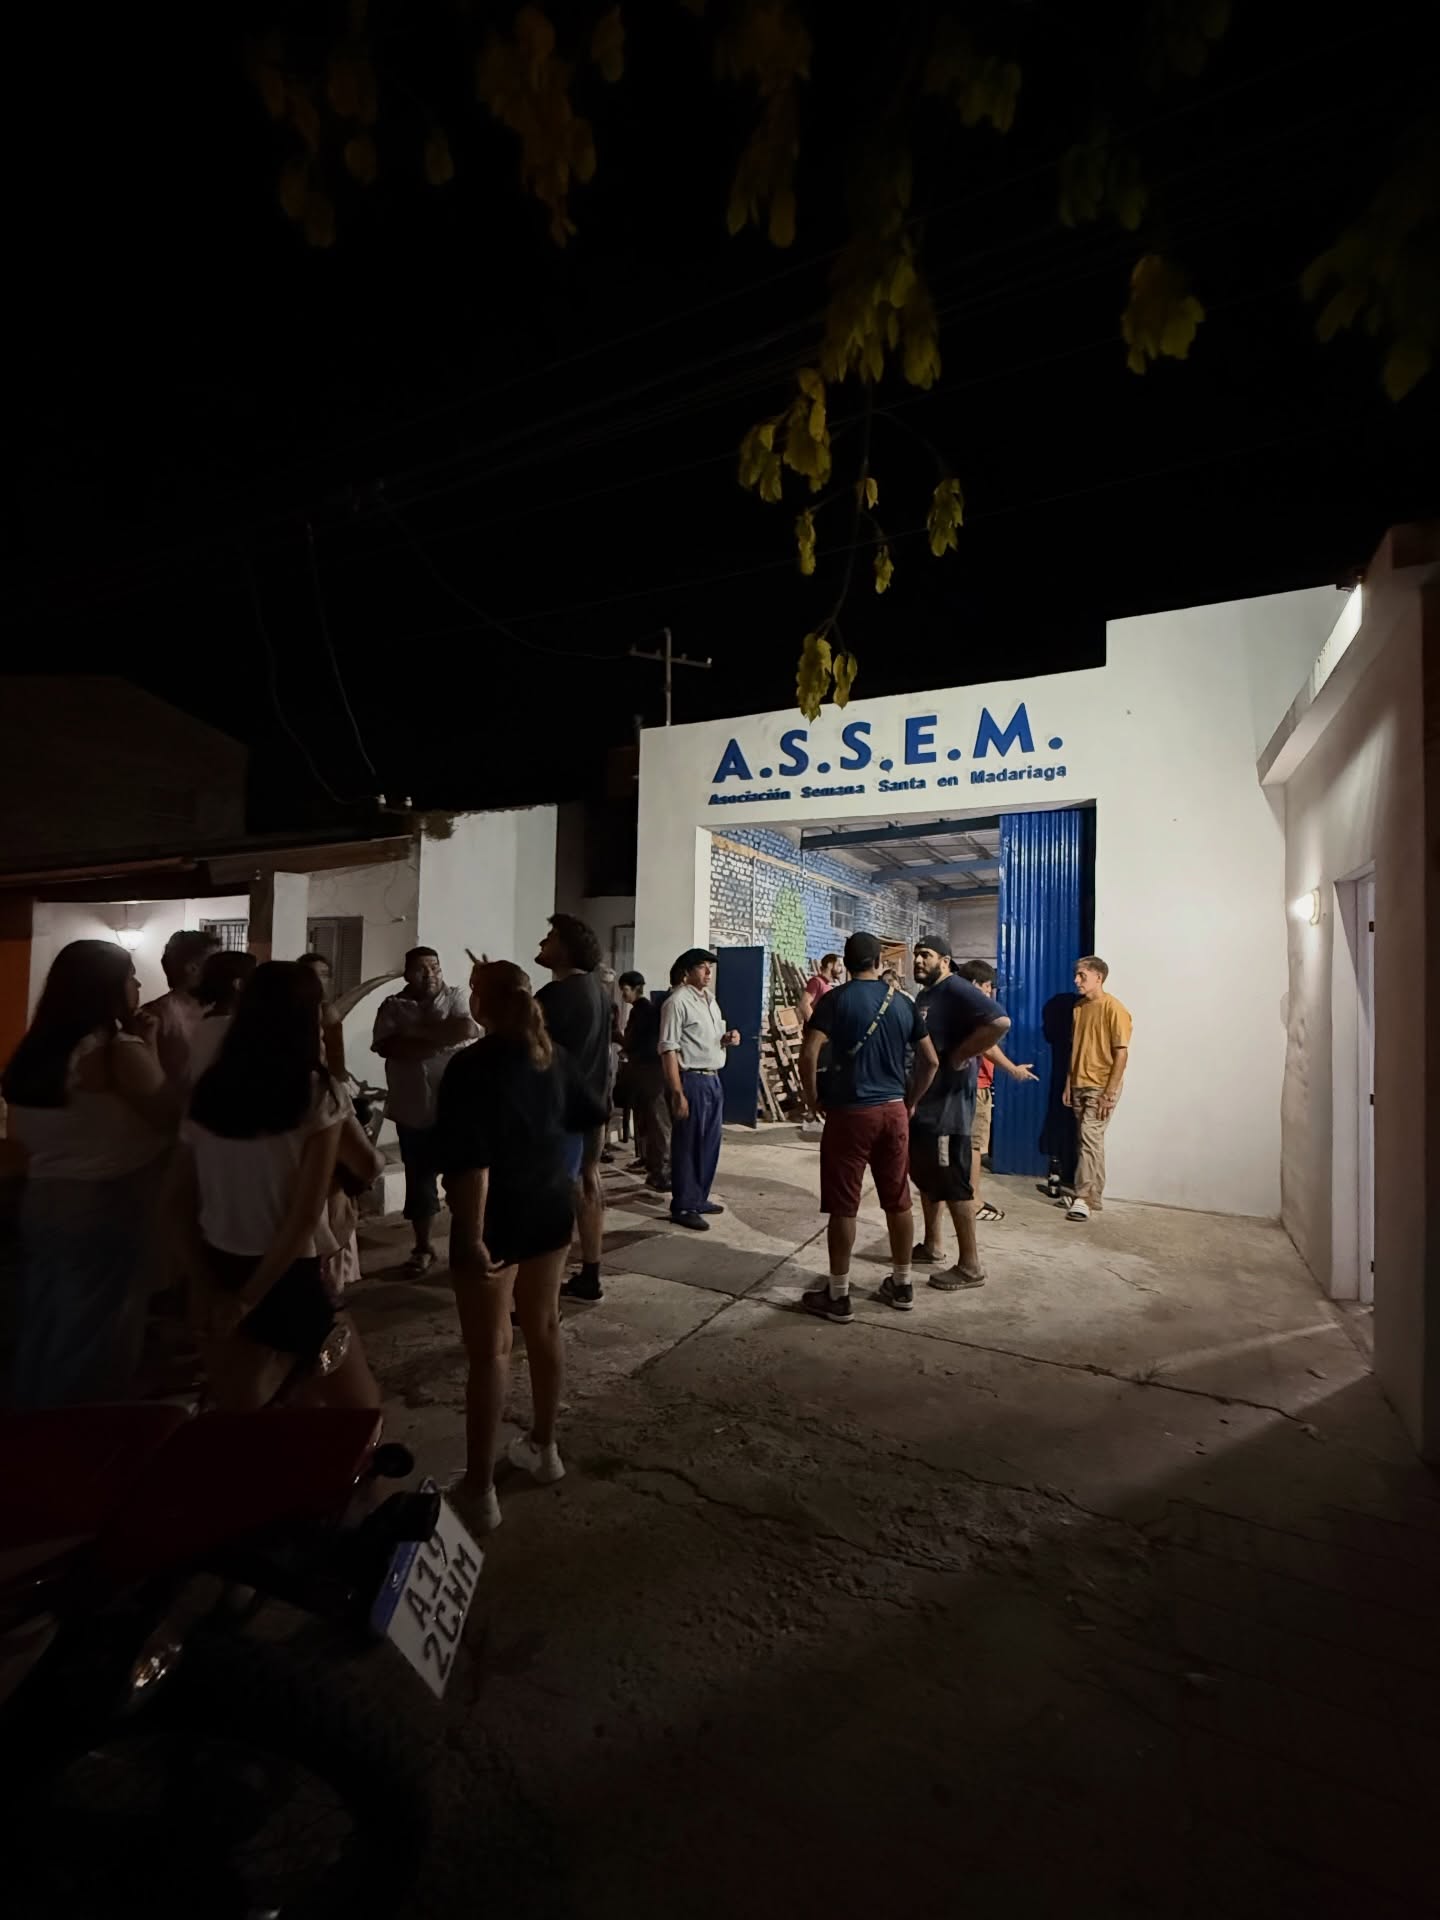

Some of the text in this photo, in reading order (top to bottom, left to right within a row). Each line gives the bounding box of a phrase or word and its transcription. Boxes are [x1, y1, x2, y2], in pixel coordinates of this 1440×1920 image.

[712, 702, 1064, 784] A.S.S.E.M.
[708, 763, 1067, 806] Asociación Semana Santa en Madariaga
